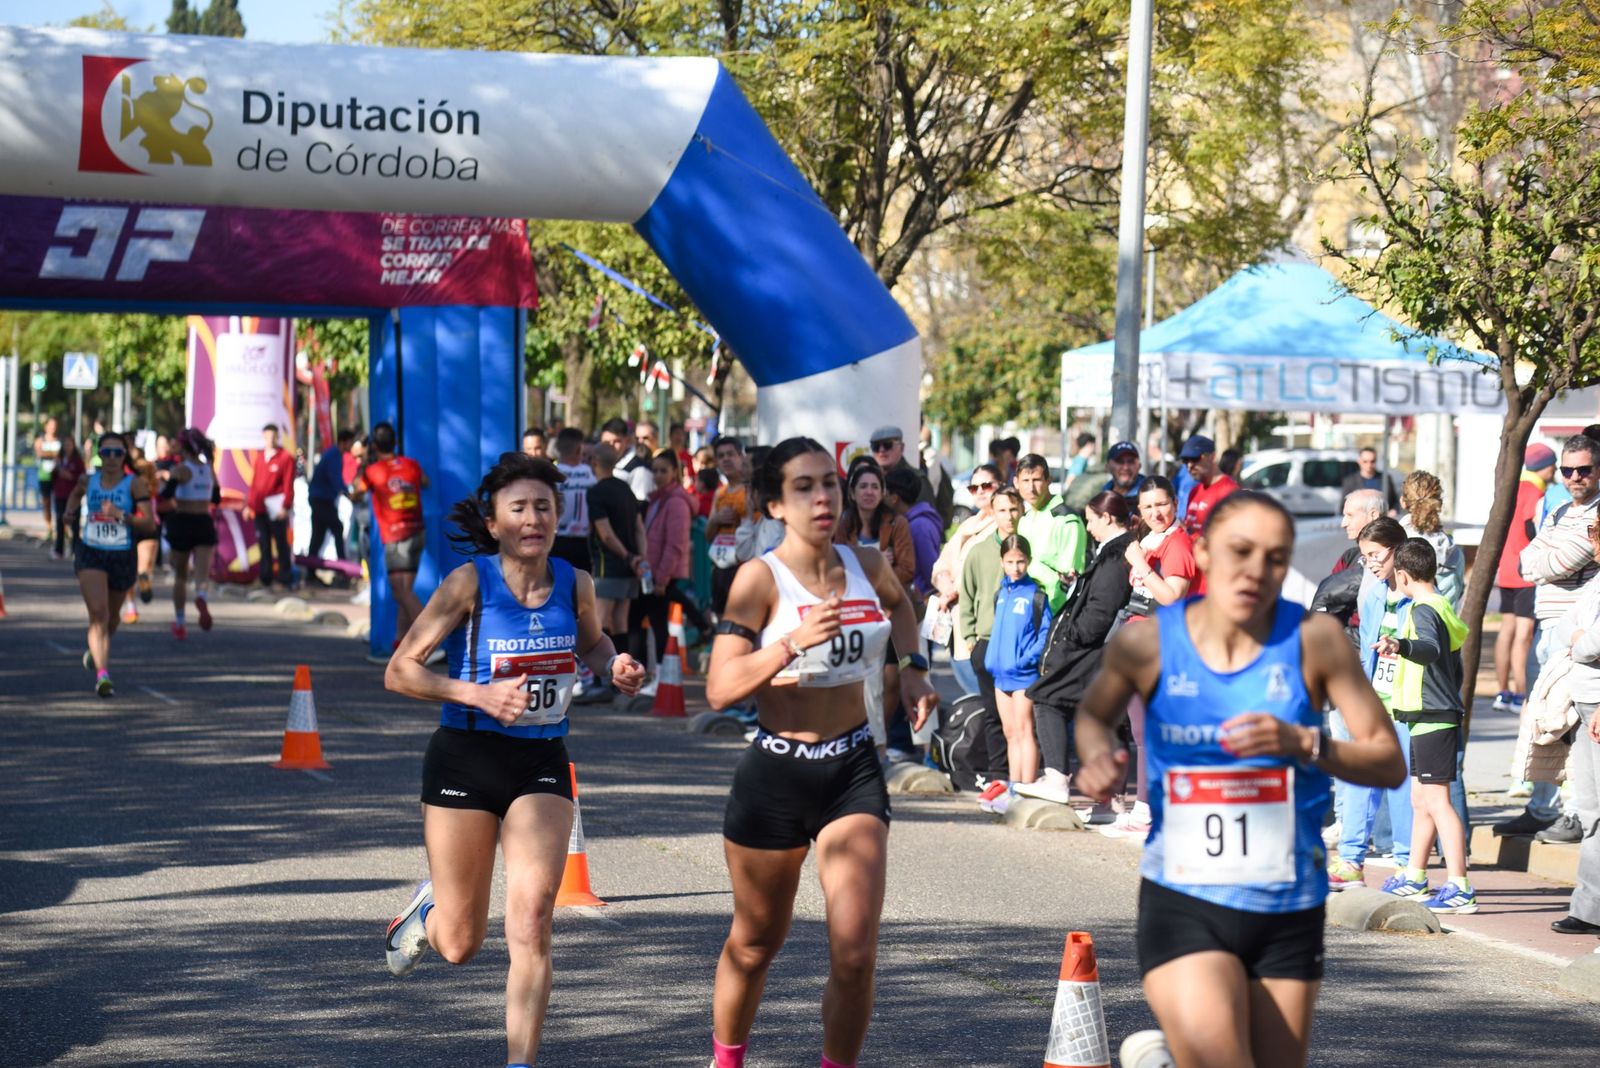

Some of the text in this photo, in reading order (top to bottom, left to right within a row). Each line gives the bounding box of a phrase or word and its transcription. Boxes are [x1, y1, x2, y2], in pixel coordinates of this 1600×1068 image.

[242, 89, 480, 136] Diputación
[237, 138, 479, 181] de Córdoba
[381, 218, 405, 235] DE
[409, 219, 481, 235] CORRER
[381, 234, 492, 251] SE TRATA DE
[380, 252, 453, 268] CORRER
[380, 268, 443, 286] MEJOR
[96, 523, 118, 538] 195
[487, 634, 576, 652] TROTASIERRA
[830, 629, 864, 667] 99
[1378, 660, 1397, 683] 55
[526, 677, 557, 712] 56
[794, 736, 850, 759] NIKE
[1204, 812, 1249, 857] 91
